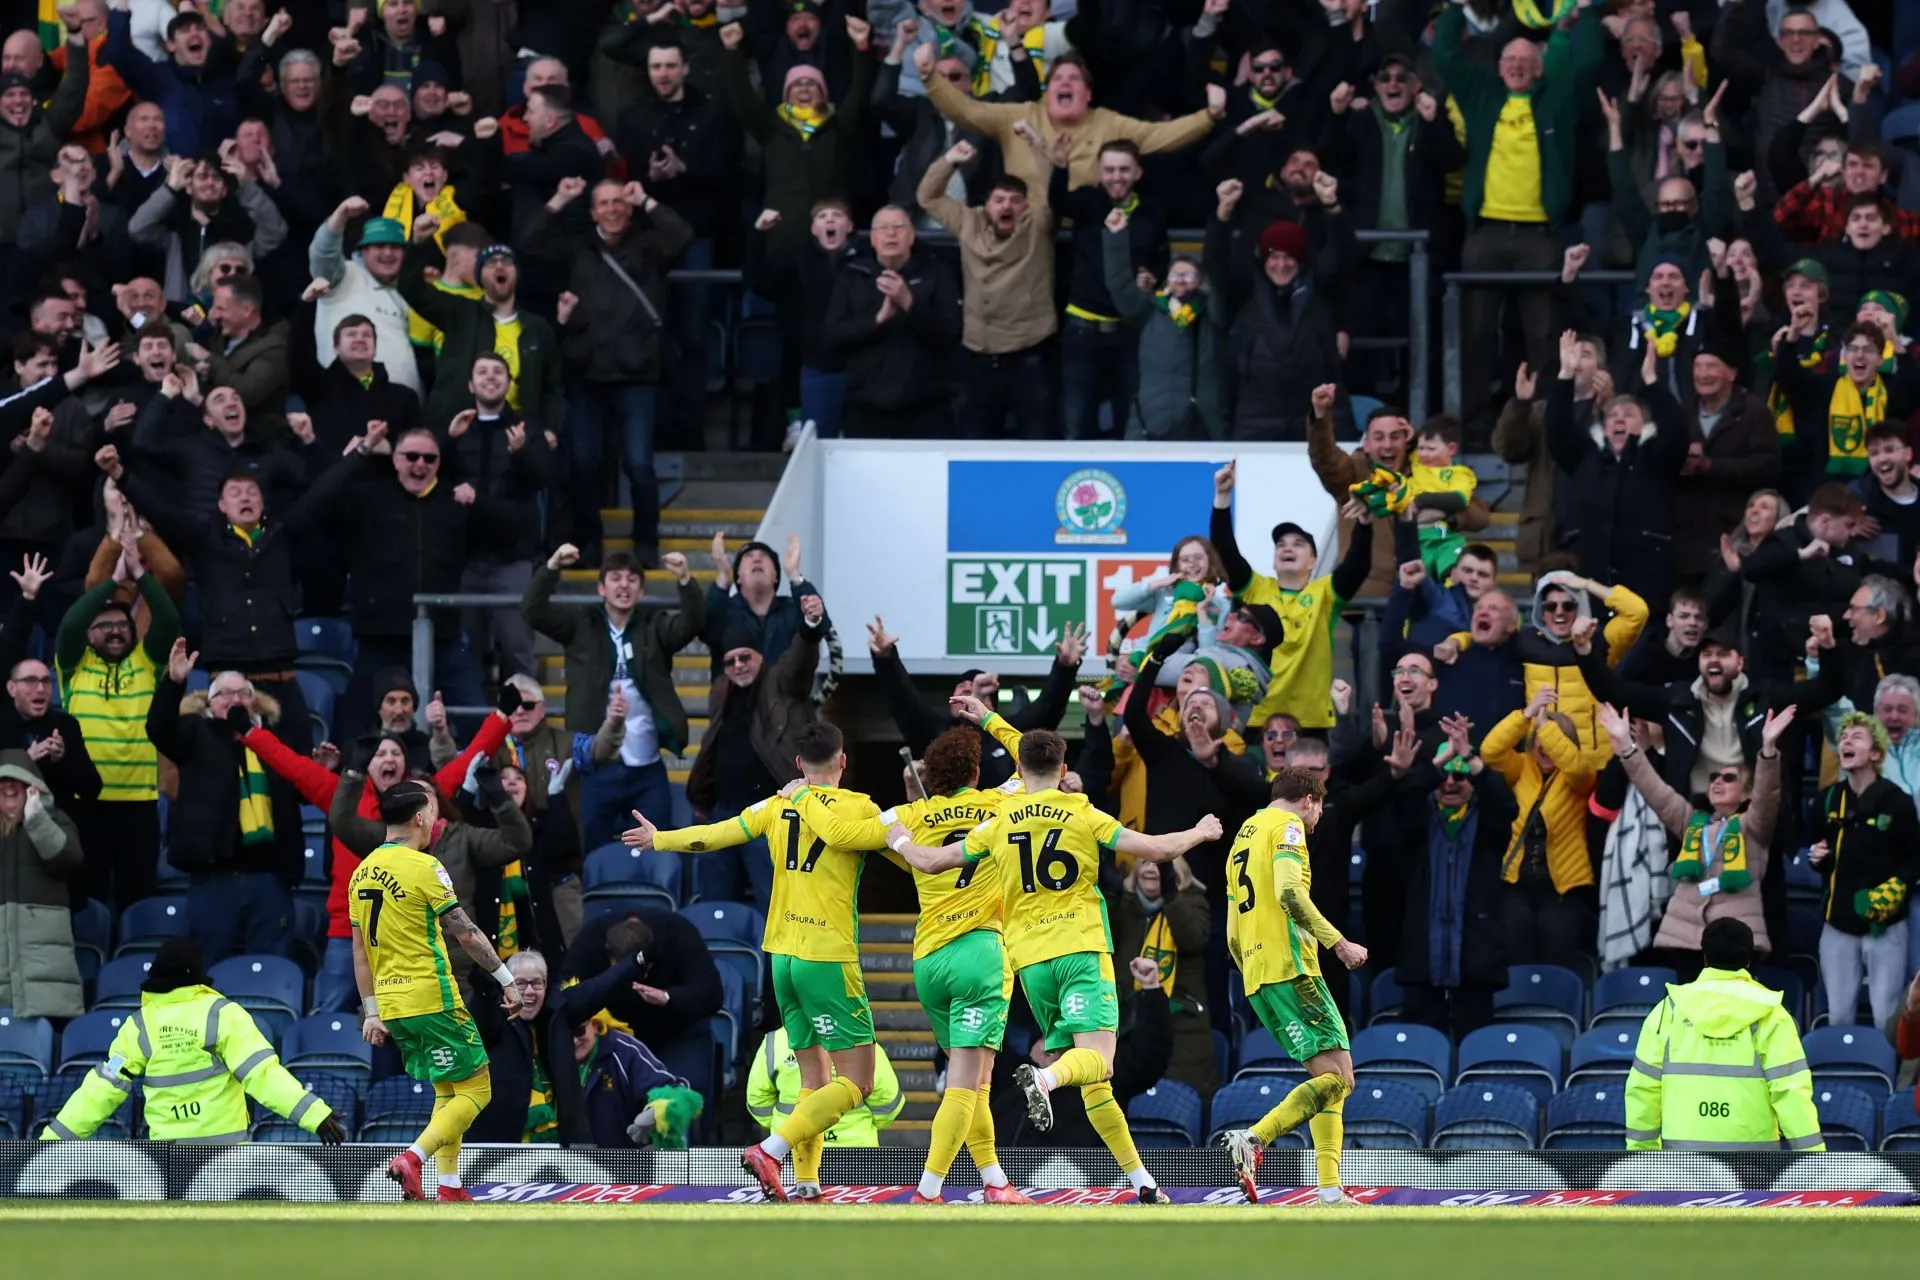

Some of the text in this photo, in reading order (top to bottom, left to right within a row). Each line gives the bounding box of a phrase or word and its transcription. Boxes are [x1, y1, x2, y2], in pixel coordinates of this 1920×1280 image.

[952, 563, 1081, 604] EXIT
[924, 805, 997, 829] SARGENT
[1009, 803, 1074, 825] WRIGHT
[1008, 828, 1079, 894] 16
[370, 866, 407, 903] SAINZ
[1233, 847, 1256, 915] 3
[358, 888, 384, 948] 7
[170, 1101, 201, 1121] 110
[1698, 1101, 1731, 1118] 086
